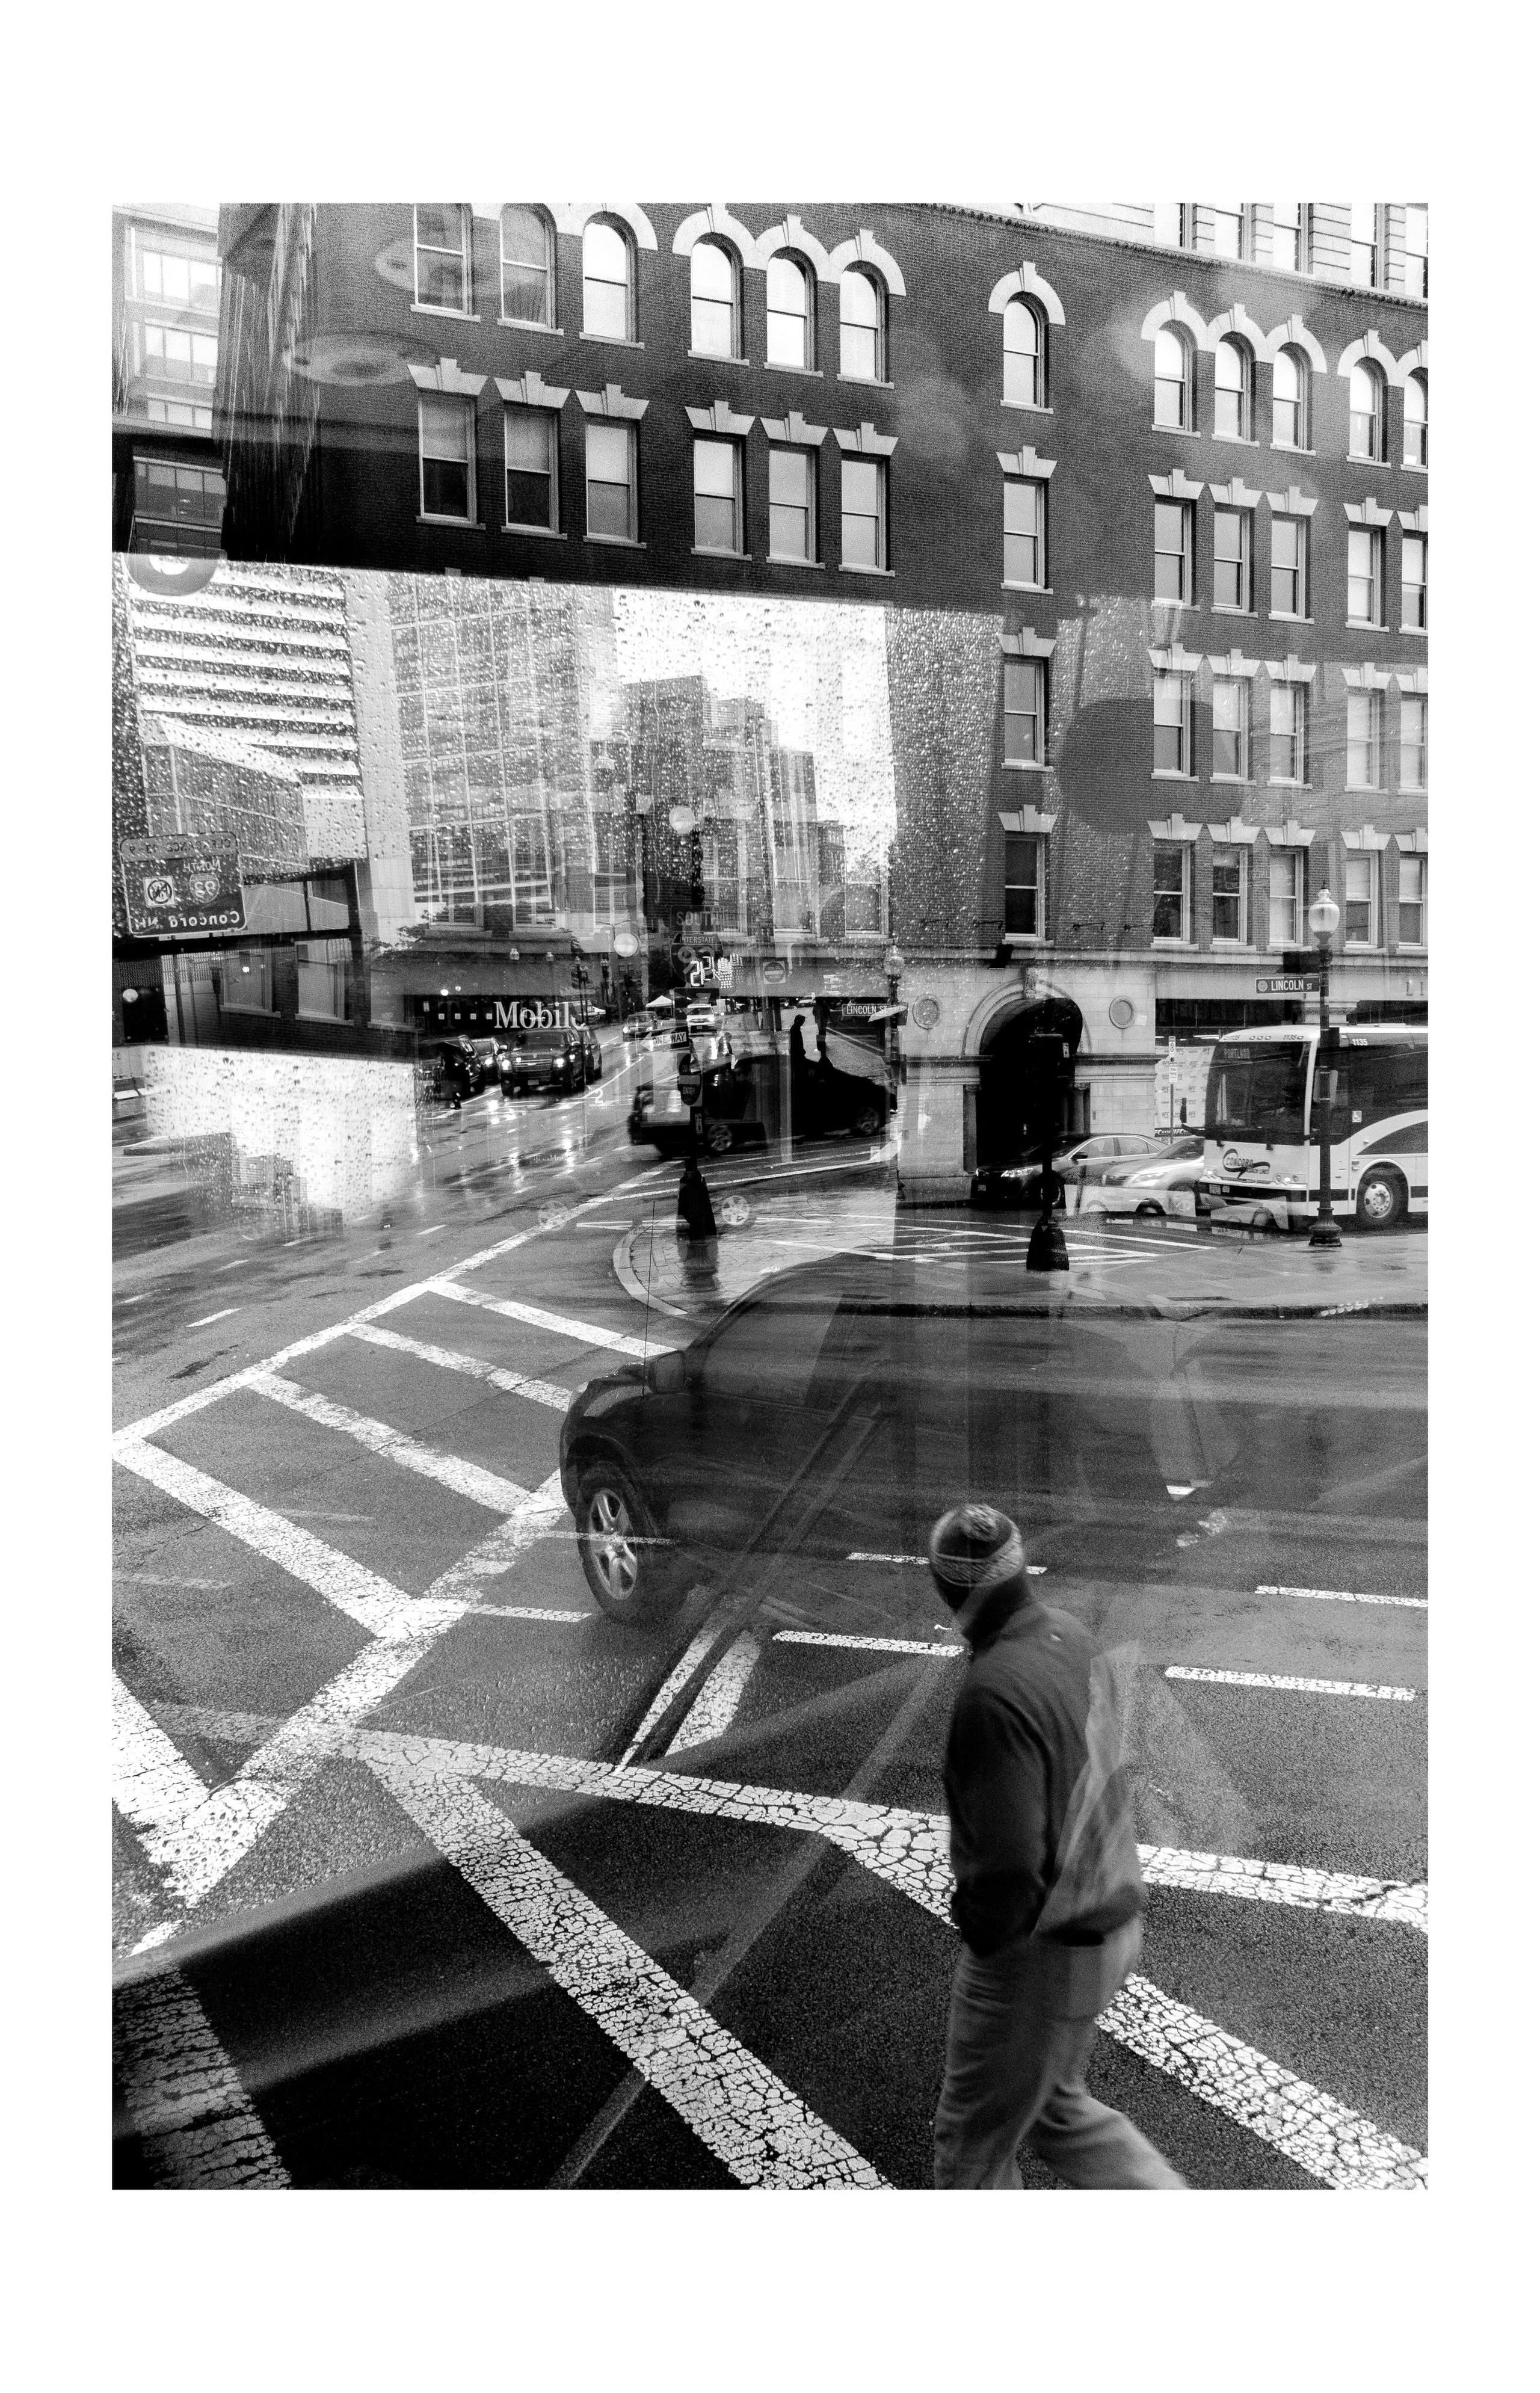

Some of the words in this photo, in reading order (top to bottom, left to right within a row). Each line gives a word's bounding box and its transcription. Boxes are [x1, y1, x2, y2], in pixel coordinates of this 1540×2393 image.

[1271, 980, 1304, 991] LINCOLN
[846, 1005, 876, 1014] LINCOLN
[879, 1005, 887, 1014] ST
[653, 1035, 667, 1046] ONE
[670, 1032, 686, 1043] WAY
